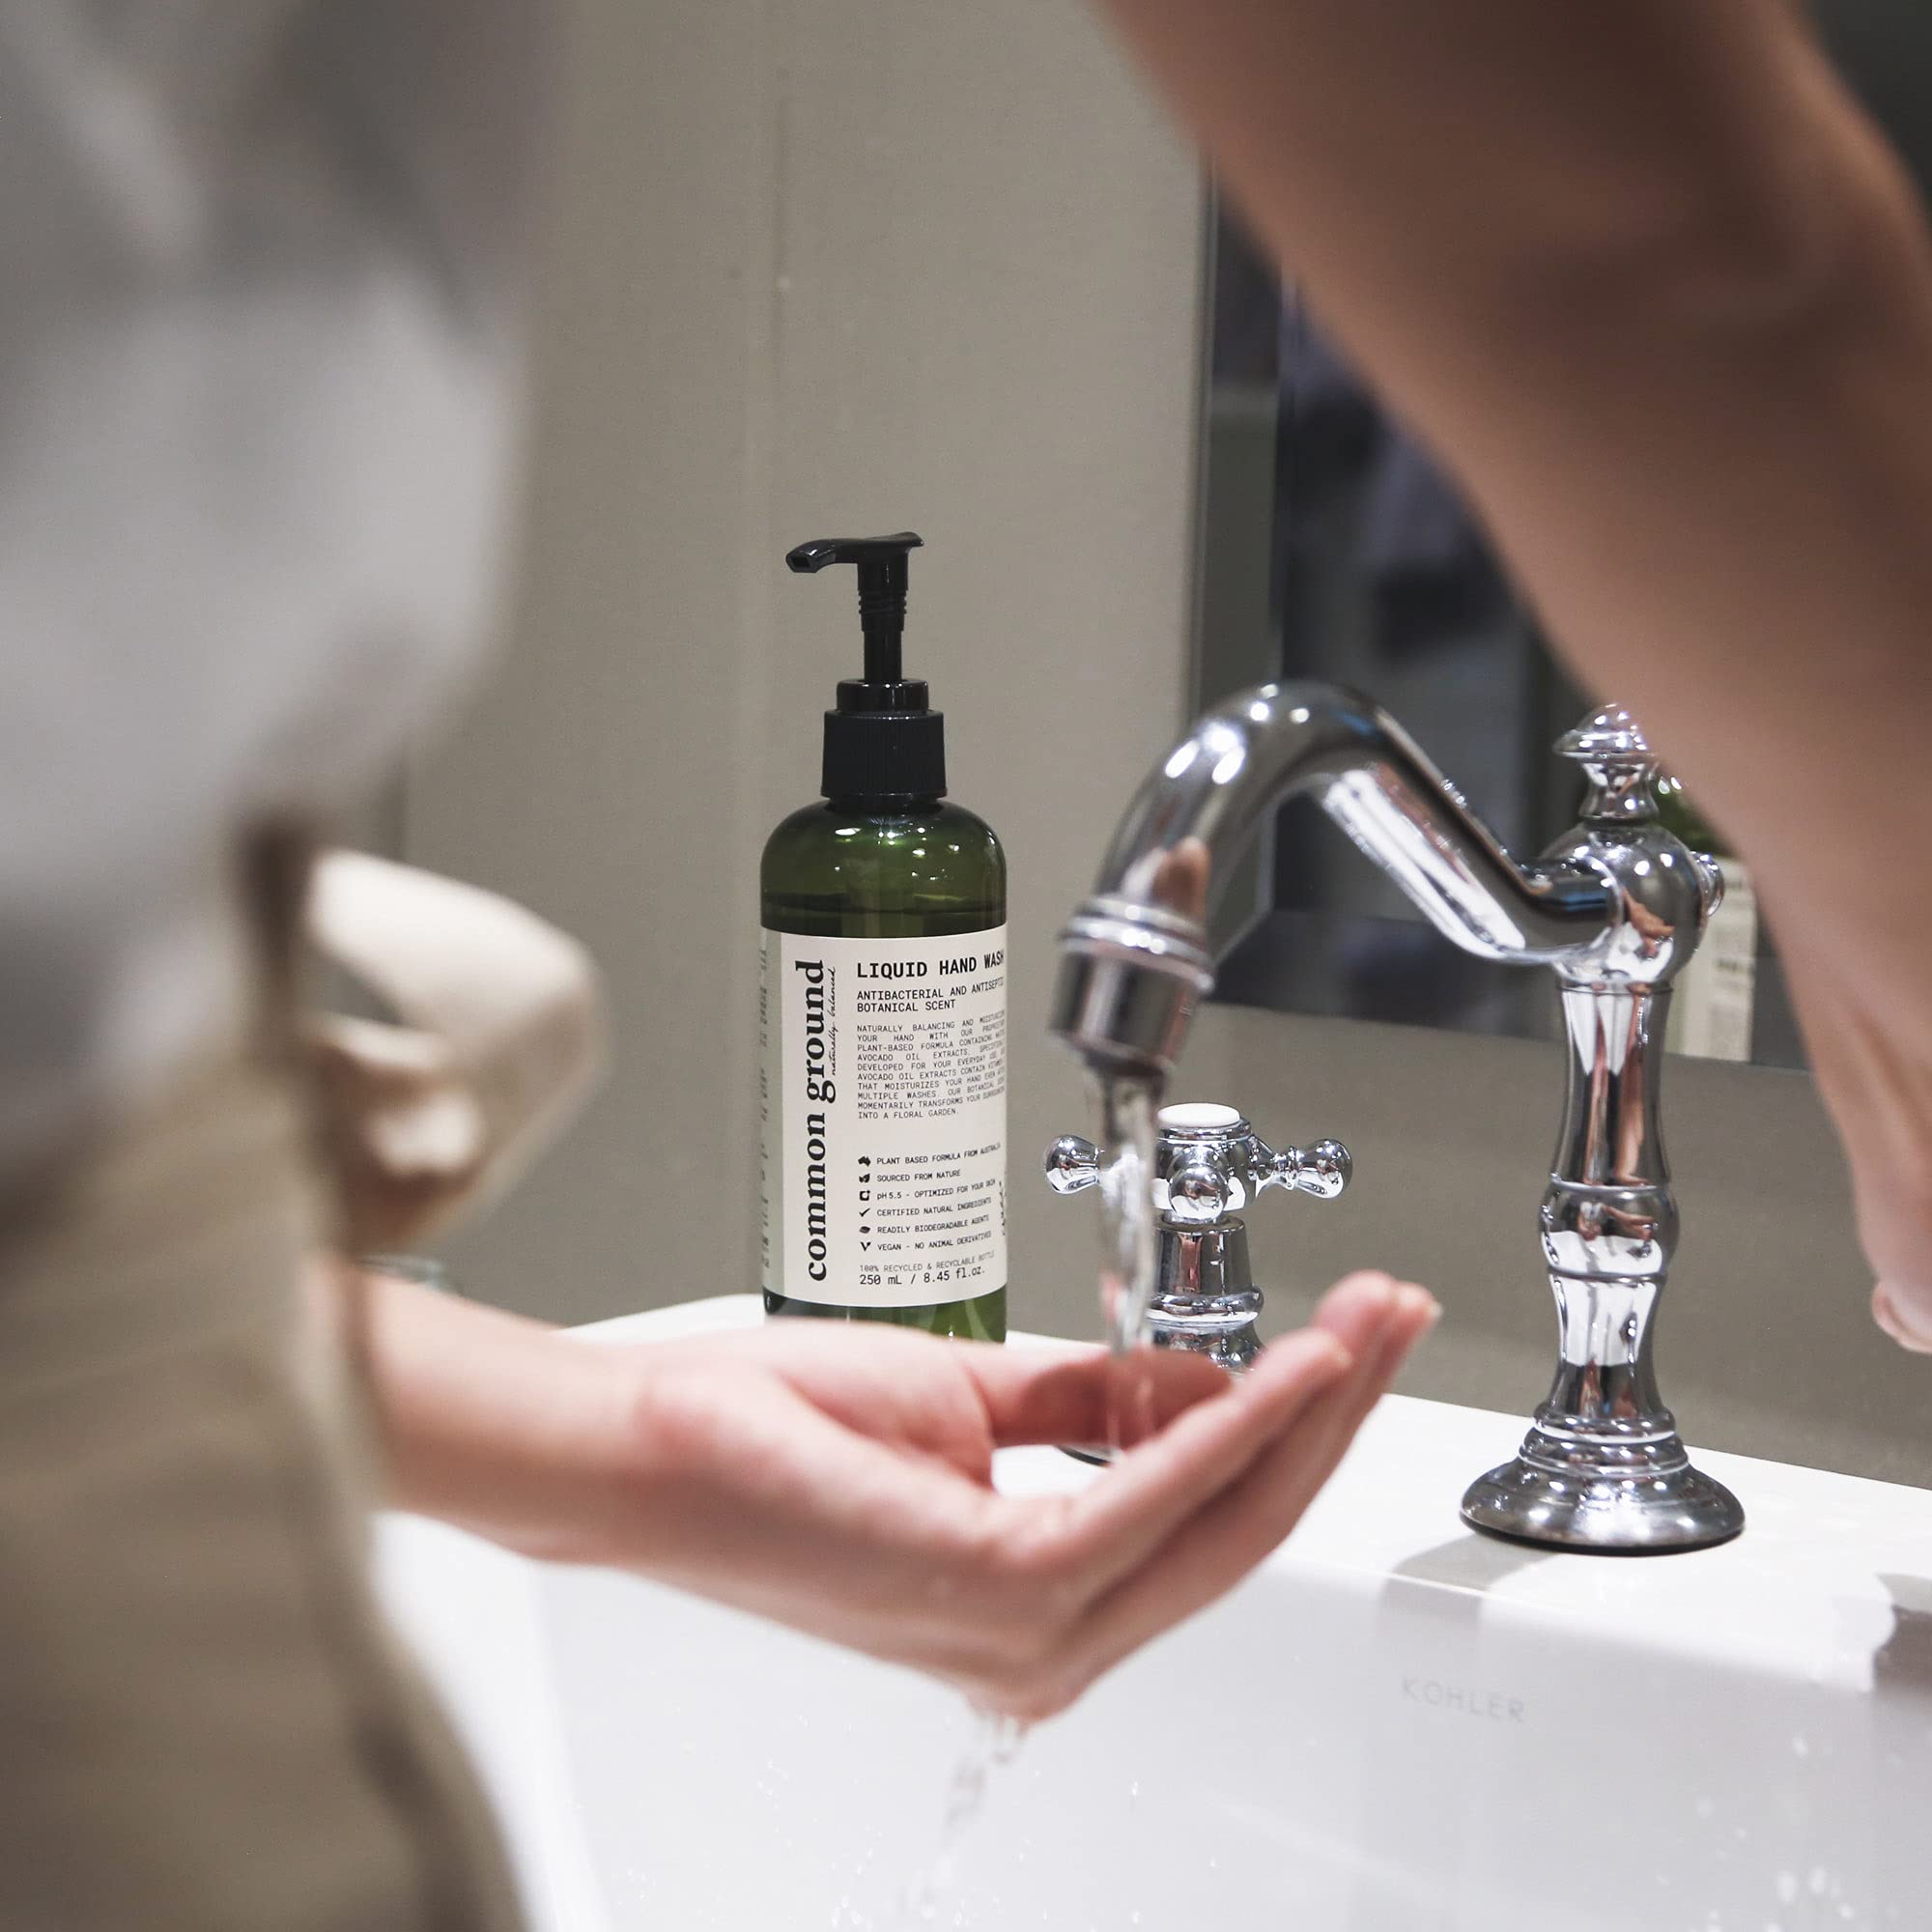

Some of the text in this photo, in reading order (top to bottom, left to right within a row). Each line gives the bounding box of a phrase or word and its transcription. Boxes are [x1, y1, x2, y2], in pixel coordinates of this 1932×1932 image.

[857, 961, 927, 980] LIQUID
[939, 956, 977, 975] HAND
[857, 988, 944, 1001] ANTIBACTERIAL
[950, 985, 967, 996] AND
[857, 999, 955, 1012] BOTANICAL SCENT
[827, 966, 838, 1075] naturally balanced
[857, 1024, 903, 1033] NATURALLY
[912, 1021, 955, 1032] BALANCING
[961, 1028, 973, 1037] OUR
[921, 1041, 953, 1050] FORMULA
[933, 1060, 952, 1068] YOUR
[957, 1055, 985, 1066] EVERYDAY
[920, 1069, 956, 1080] EXTRACTS
[960, 1065, 985, 1075] CONTAIN
[858, 1082, 878, 1091] THAT
[885, 1080, 939, 1091] MOISTURIZES
[945, 1077, 962, 1087] YOUR
[948, 1088, 961, 1096] OUR
[858, 1101, 914, 1110] MOMENTARILY
[919, 1096, 963, 1107] TRANSFORMS
[795, 959, 837, 1281] common ground
[859, 1111, 878, 1120] INTO
[894, 1110, 923, 1119] FLORAL
[876, 1156, 900, 1165] PLANT
[904, 1155, 928, 1164] BASED
[932, 1152, 961, 1162] FORMULA
[963, 1149, 978, 1158] FROM
[876, 1169, 961, 1182] SOURCED FROM NATURE
[914, 1187, 953, 1198] OPTIMIZED
[956, 1184, 969, 1194] FOR
[971, 1181, 984, 1191] YOUR
[876, 1208, 920, 1217] CERTIFIED
[923, 1206, 953, 1214] NATURAL
[877, 1225, 911, 1234] READILY
[914, 1219, 968, 1233] BIODEGRADABLE
[914, 1241, 924, 1250] NO
[928, 1239, 954, 1248] ANIMAL
[859, 1264, 879, 1273] 100%
[883, 1263, 923, 1272] RECYCLED
[936, 1256, 976, 1269] RECYCLABLE
[859, 1273, 881, 1285] 250
[887, 1274, 902, 1285] mL
[923, 1269, 950, 1283] 8.45
[1402, 1676, 1525, 1723] KOHLER
